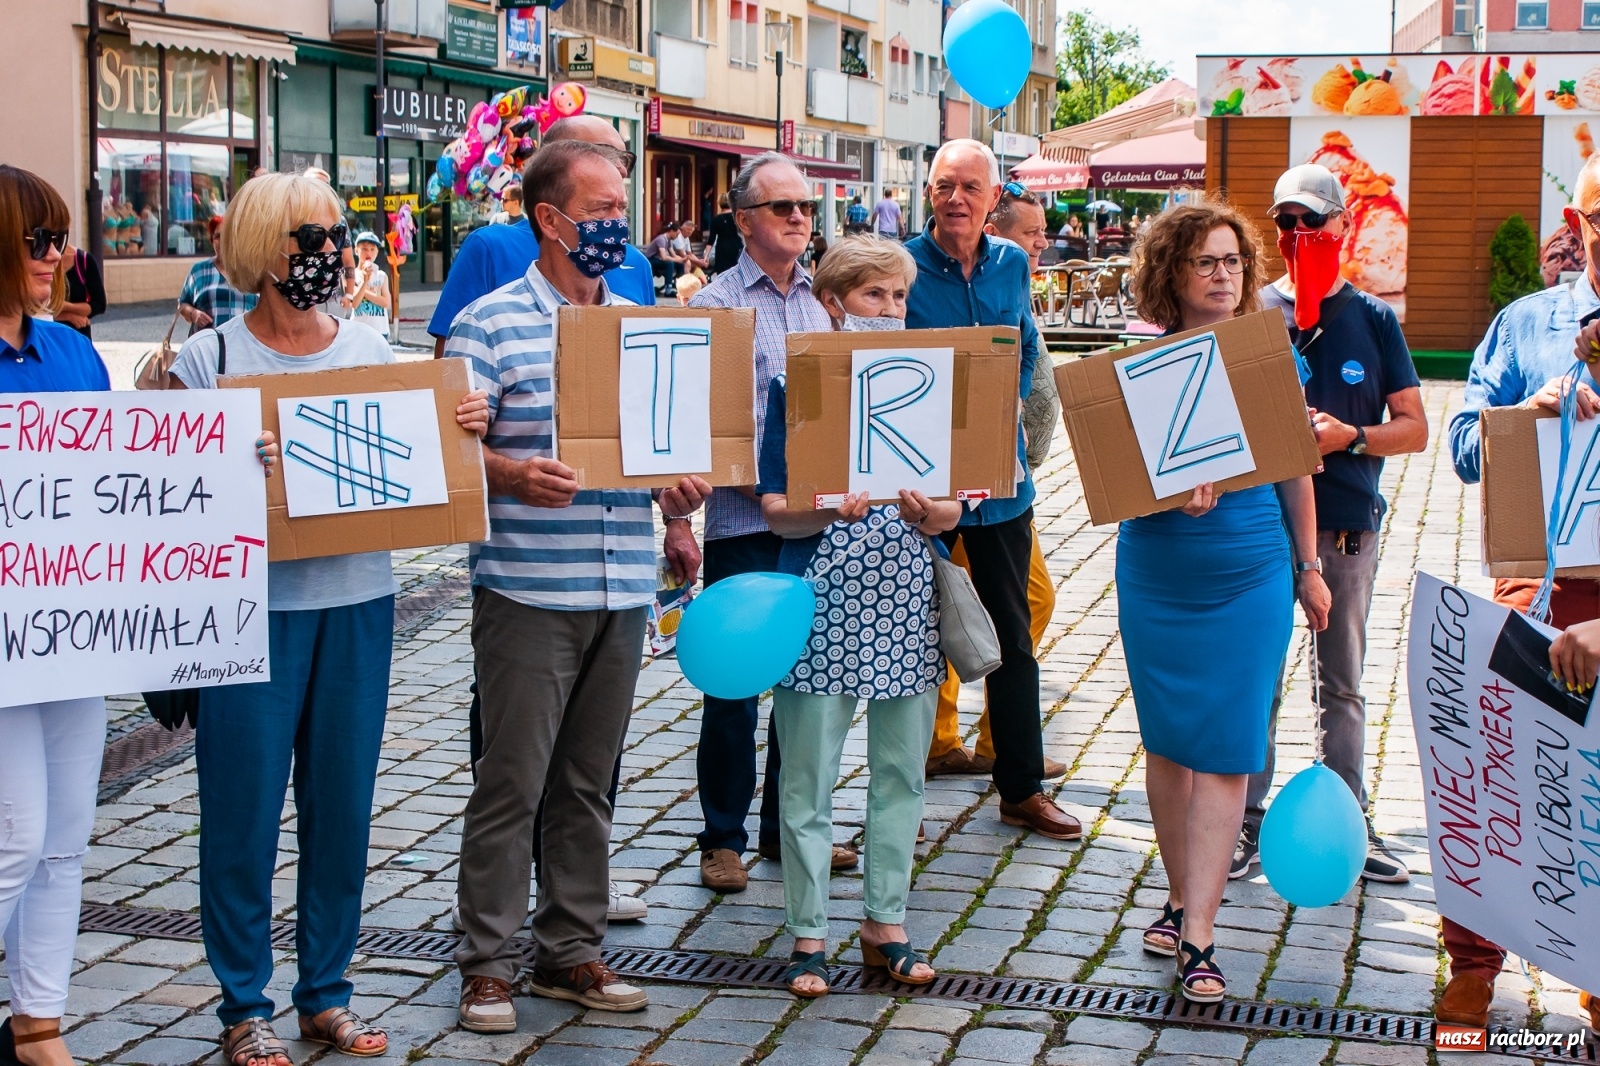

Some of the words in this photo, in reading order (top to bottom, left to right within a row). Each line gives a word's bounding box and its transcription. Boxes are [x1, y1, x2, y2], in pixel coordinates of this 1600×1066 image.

[98, 47, 222, 121] STELLA
[383, 88, 467, 124] JUBILER
[402, 123, 417, 134] 1989
[1101, 170, 1152, 187] Gelateria
[1154, 169, 1178, 181] Ciao
[1181, 168, 1206, 180] Ital
[624, 327, 710, 455] T
[1124, 330, 1245, 478] Z
[124, 407, 225, 456] DAMA
[857, 356, 936, 478] R
[94, 473, 213, 516] STAŁA
[1, 541, 127, 588] RAWACH
[141, 535, 265, 584] KOBIET
[1426, 585, 1472, 749] MARNEGO
[1535, 919, 1577, 962] W
